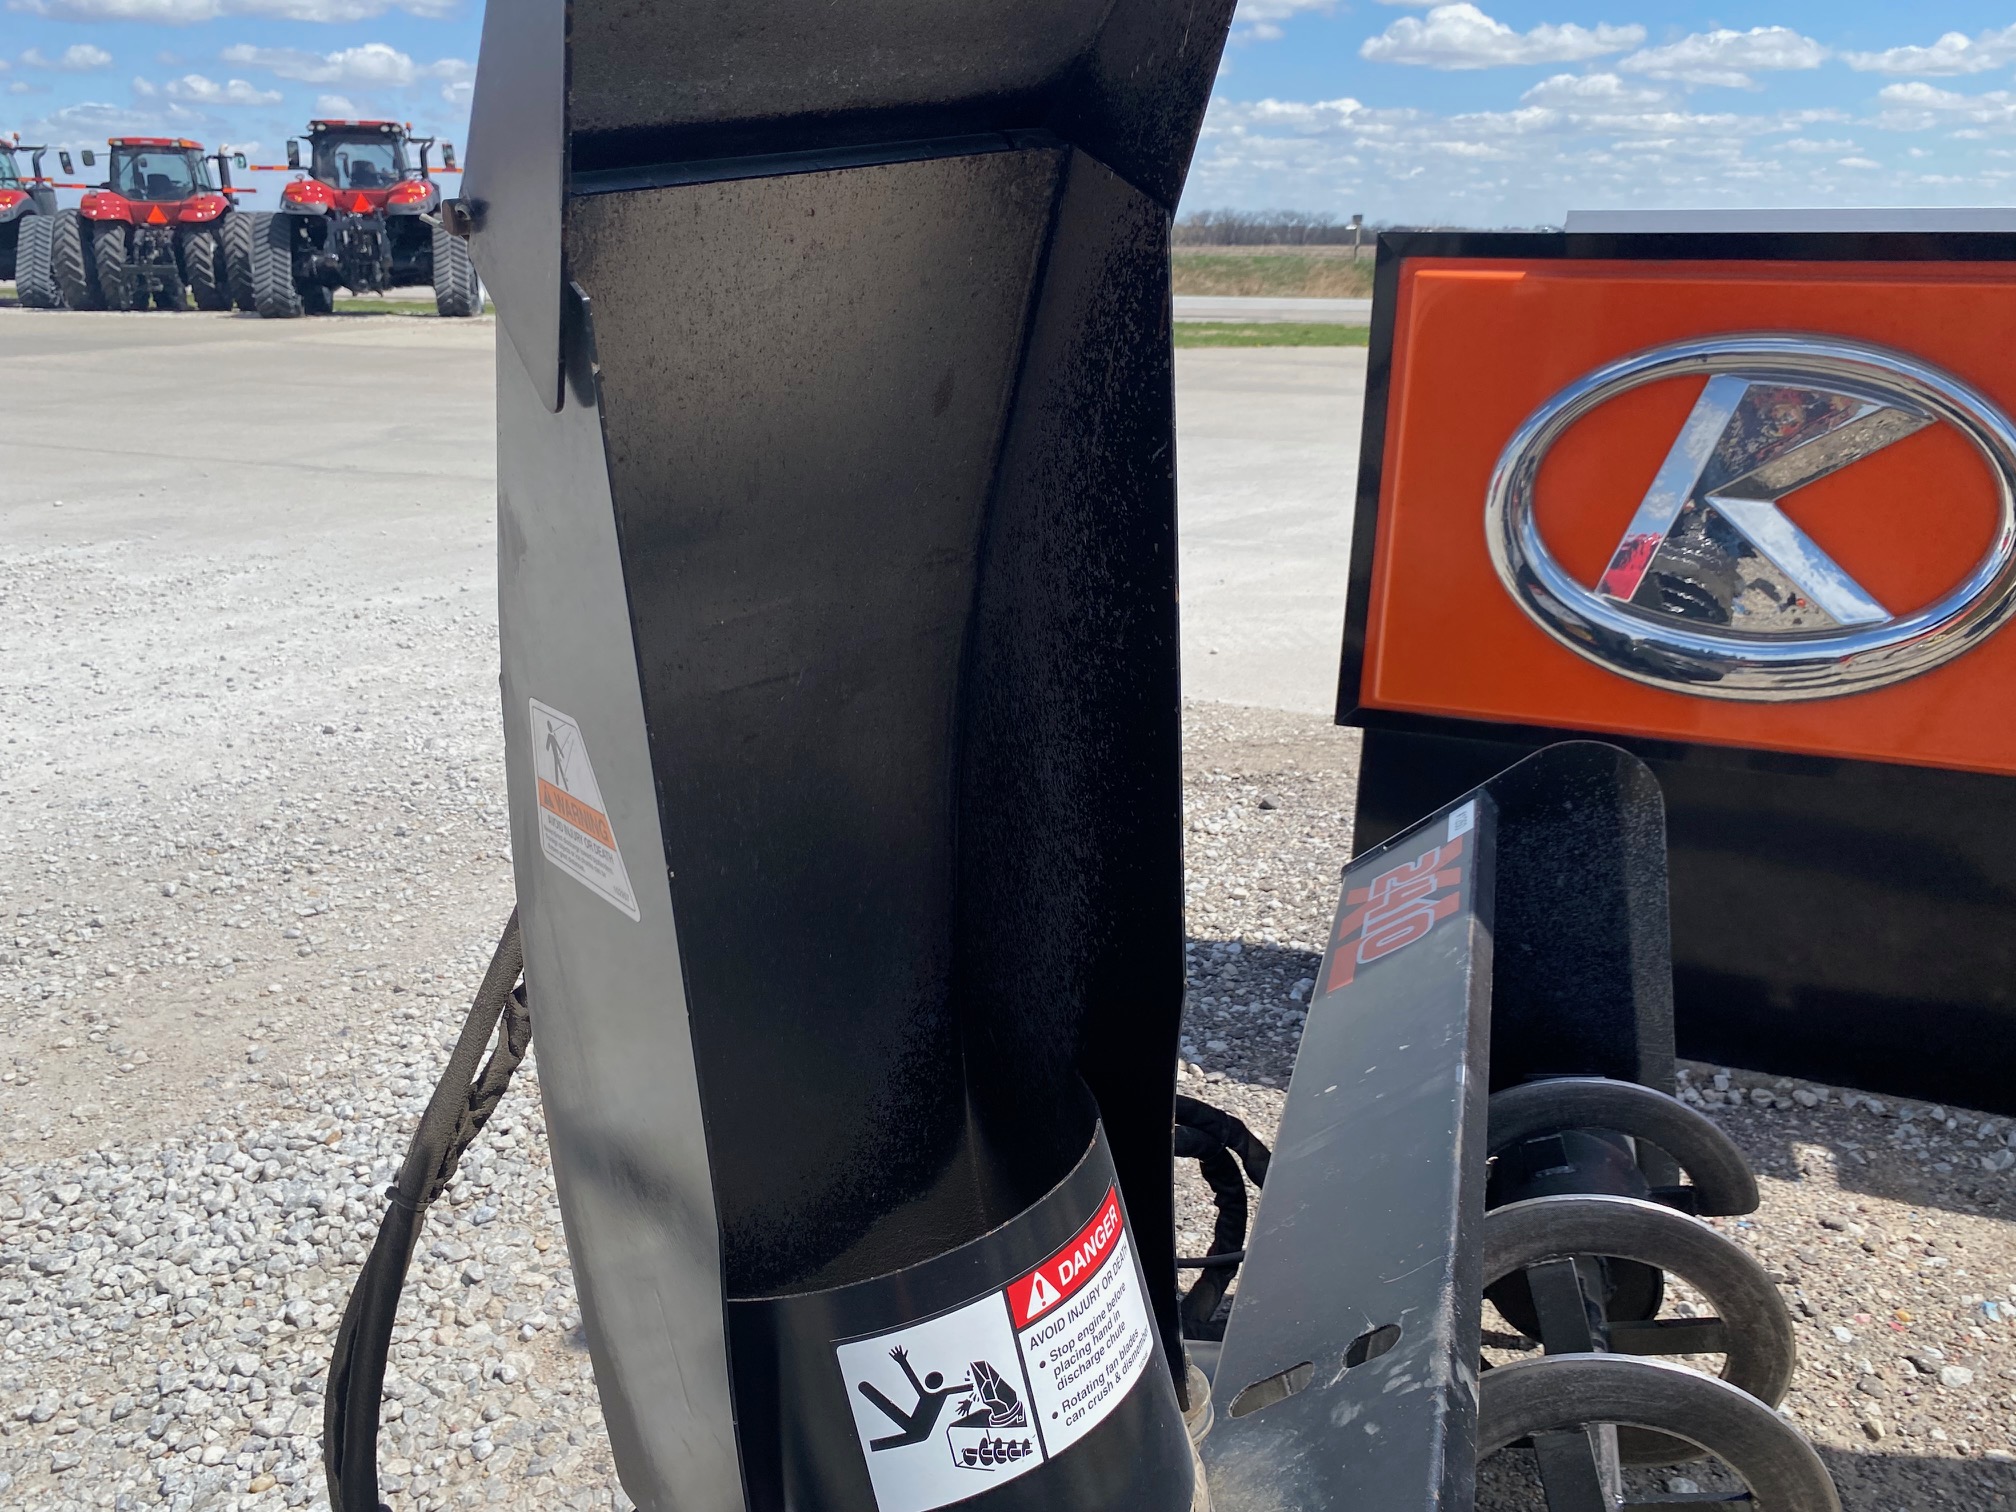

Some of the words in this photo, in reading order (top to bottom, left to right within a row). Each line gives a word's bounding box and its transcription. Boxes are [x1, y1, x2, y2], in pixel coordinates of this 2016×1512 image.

[554, 792, 610, 843] WARNING
[1357, 846, 1440, 964] 2410
[1058, 1204, 1118, 1287] DANGER
[1030, 1318, 1066, 1351] AVOID
[1067, 1284, 1100, 1324] INJURY
[1102, 1271, 1114, 1290] OR
[1112, 1243, 1128, 1276] DEATH
[1050, 1339, 1075, 1362] Stop
[1077, 1310, 1106, 1341] engine
[1106, 1283, 1126, 1312] before
[1054, 1342, 1092, 1379] placing
[1092, 1320, 1113, 1346] hand
[1112, 1310, 1121, 1329] in
[1057, 1347, 1105, 1390] discharge
[1106, 1321, 1126, 1349] chute
[1062, 1373, 1105, 1413] Rotating
[1105, 1358, 1119, 1376] fan
[1119, 1328, 1139, 1360] blades
[1065, 1407, 1086, 1427] can
[1087, 1381, 1114, 1410] crush
[1114, 1371, 1122, 1384] &
[1122, 1325, 1149, 1375] dismember
